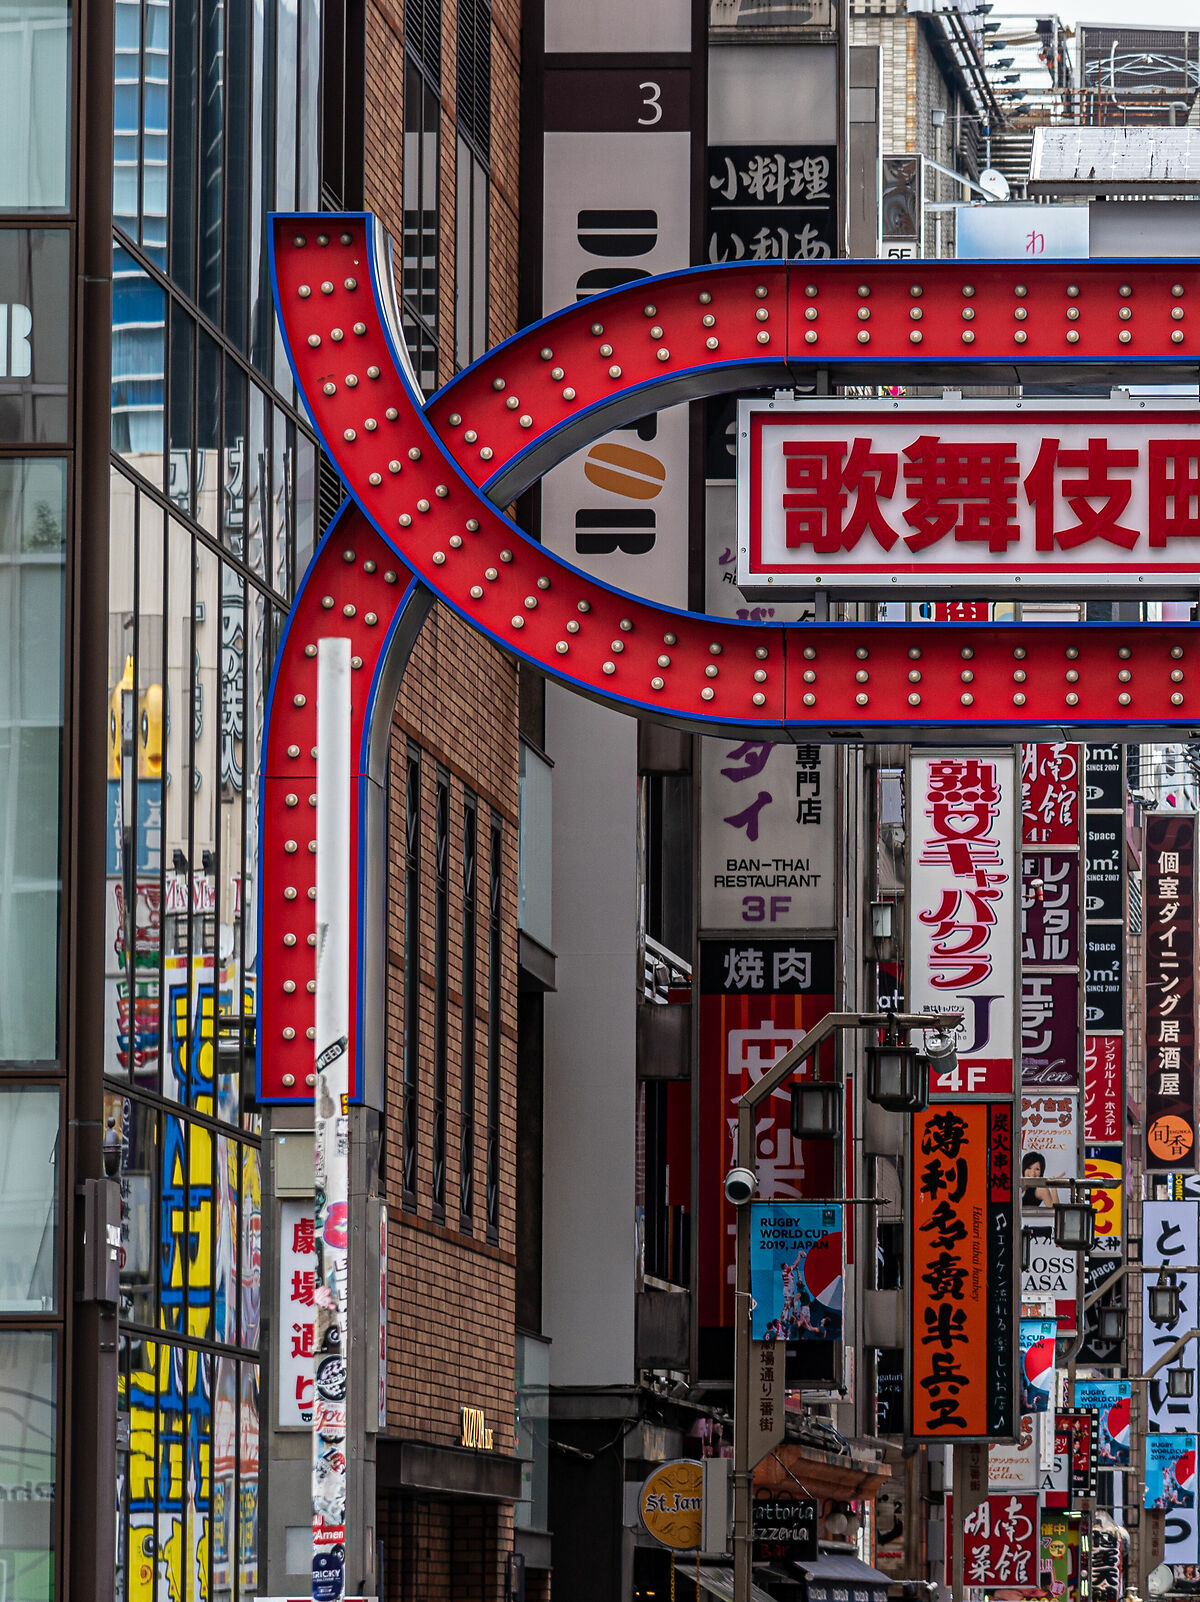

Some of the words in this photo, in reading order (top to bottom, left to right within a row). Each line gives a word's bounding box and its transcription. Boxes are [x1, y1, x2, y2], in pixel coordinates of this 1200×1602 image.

[638, 82, 663, 125] 3
[709, 153, 831, 204] 小料理
[1025, 229, 1045, 254] わ
[1103, 764, 1120, 772] 2007
[796, 744, 822, 825] 専門店
[1026, 828, 1051, 842] 4F
[1089, 830, 1116, 842] Space
[727, 859, 810, 871] BAN-THAI
[714, 875, 821, 888] RESTAURANT
[1103, 874, 1120, 882] 2007
[742, 896, 792, 922] 3F
[1043, 857, 1070, 961] レンタル
[1089, 941, 1116, 952] Space
[723, 947, 812, 989] 焼肉
[1158, 851, 1181, 1096] 個室ダイニング居酒屋
[956, 995, 1005, 1054] J
[936, 1067, 987, 1092] 4F
[1104, 1037, 1116, 1097] レンタルルーム
[1104, 1102, 1116, 1136] ホステル
[990, 1112, 1011, 1192] 炭火串焼
[760, 1217, 801, 1229] RUGBY
[760, 1229, 804, 1239] WORLD
[805, 1230, 829, 1239] CUP
[760, 1241, 788, 1251] 2019,
[790, 1241, 829, 1251] JAPAN
[1025, 1257, 1075, 1274] OSS
